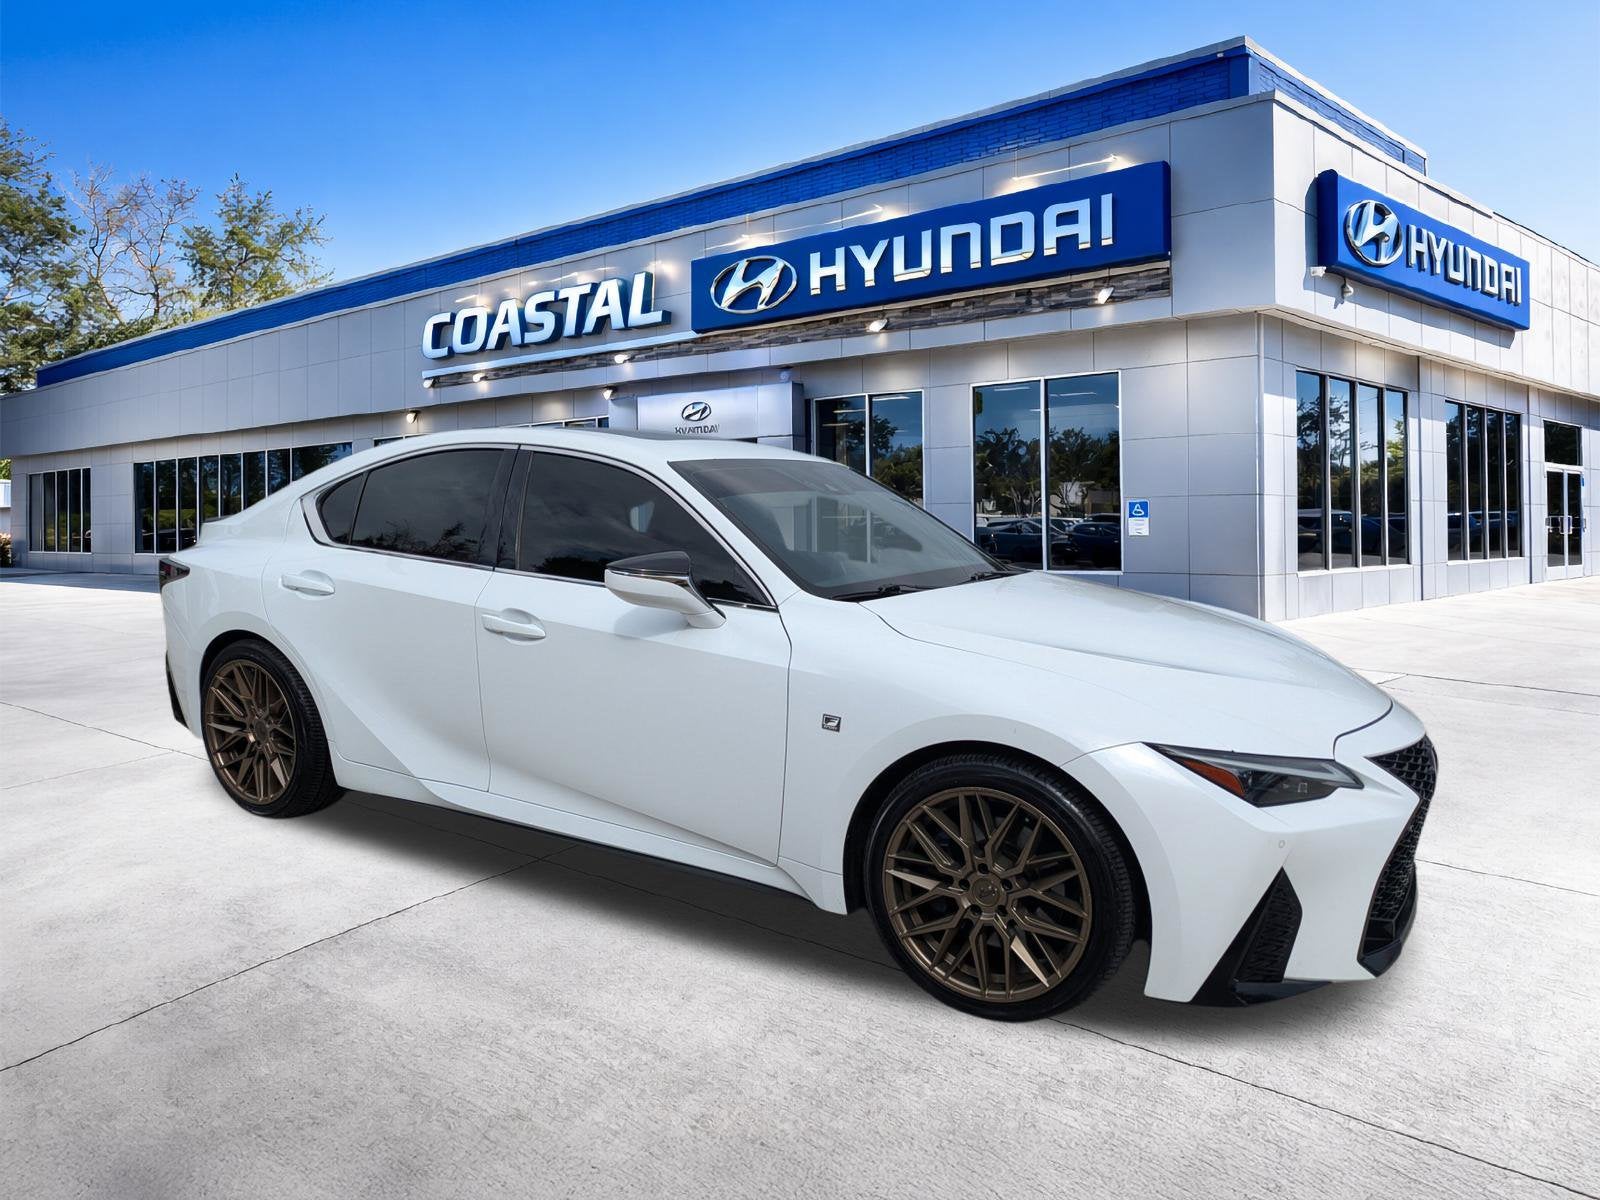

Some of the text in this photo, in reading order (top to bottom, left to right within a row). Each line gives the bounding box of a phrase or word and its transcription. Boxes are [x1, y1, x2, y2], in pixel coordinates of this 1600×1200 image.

[809, 193, 1114, 296] HYUNDAI
[1406, 223, 1522, 306] HYUNDAI
[422, 271, 668, 359] COASTAL
